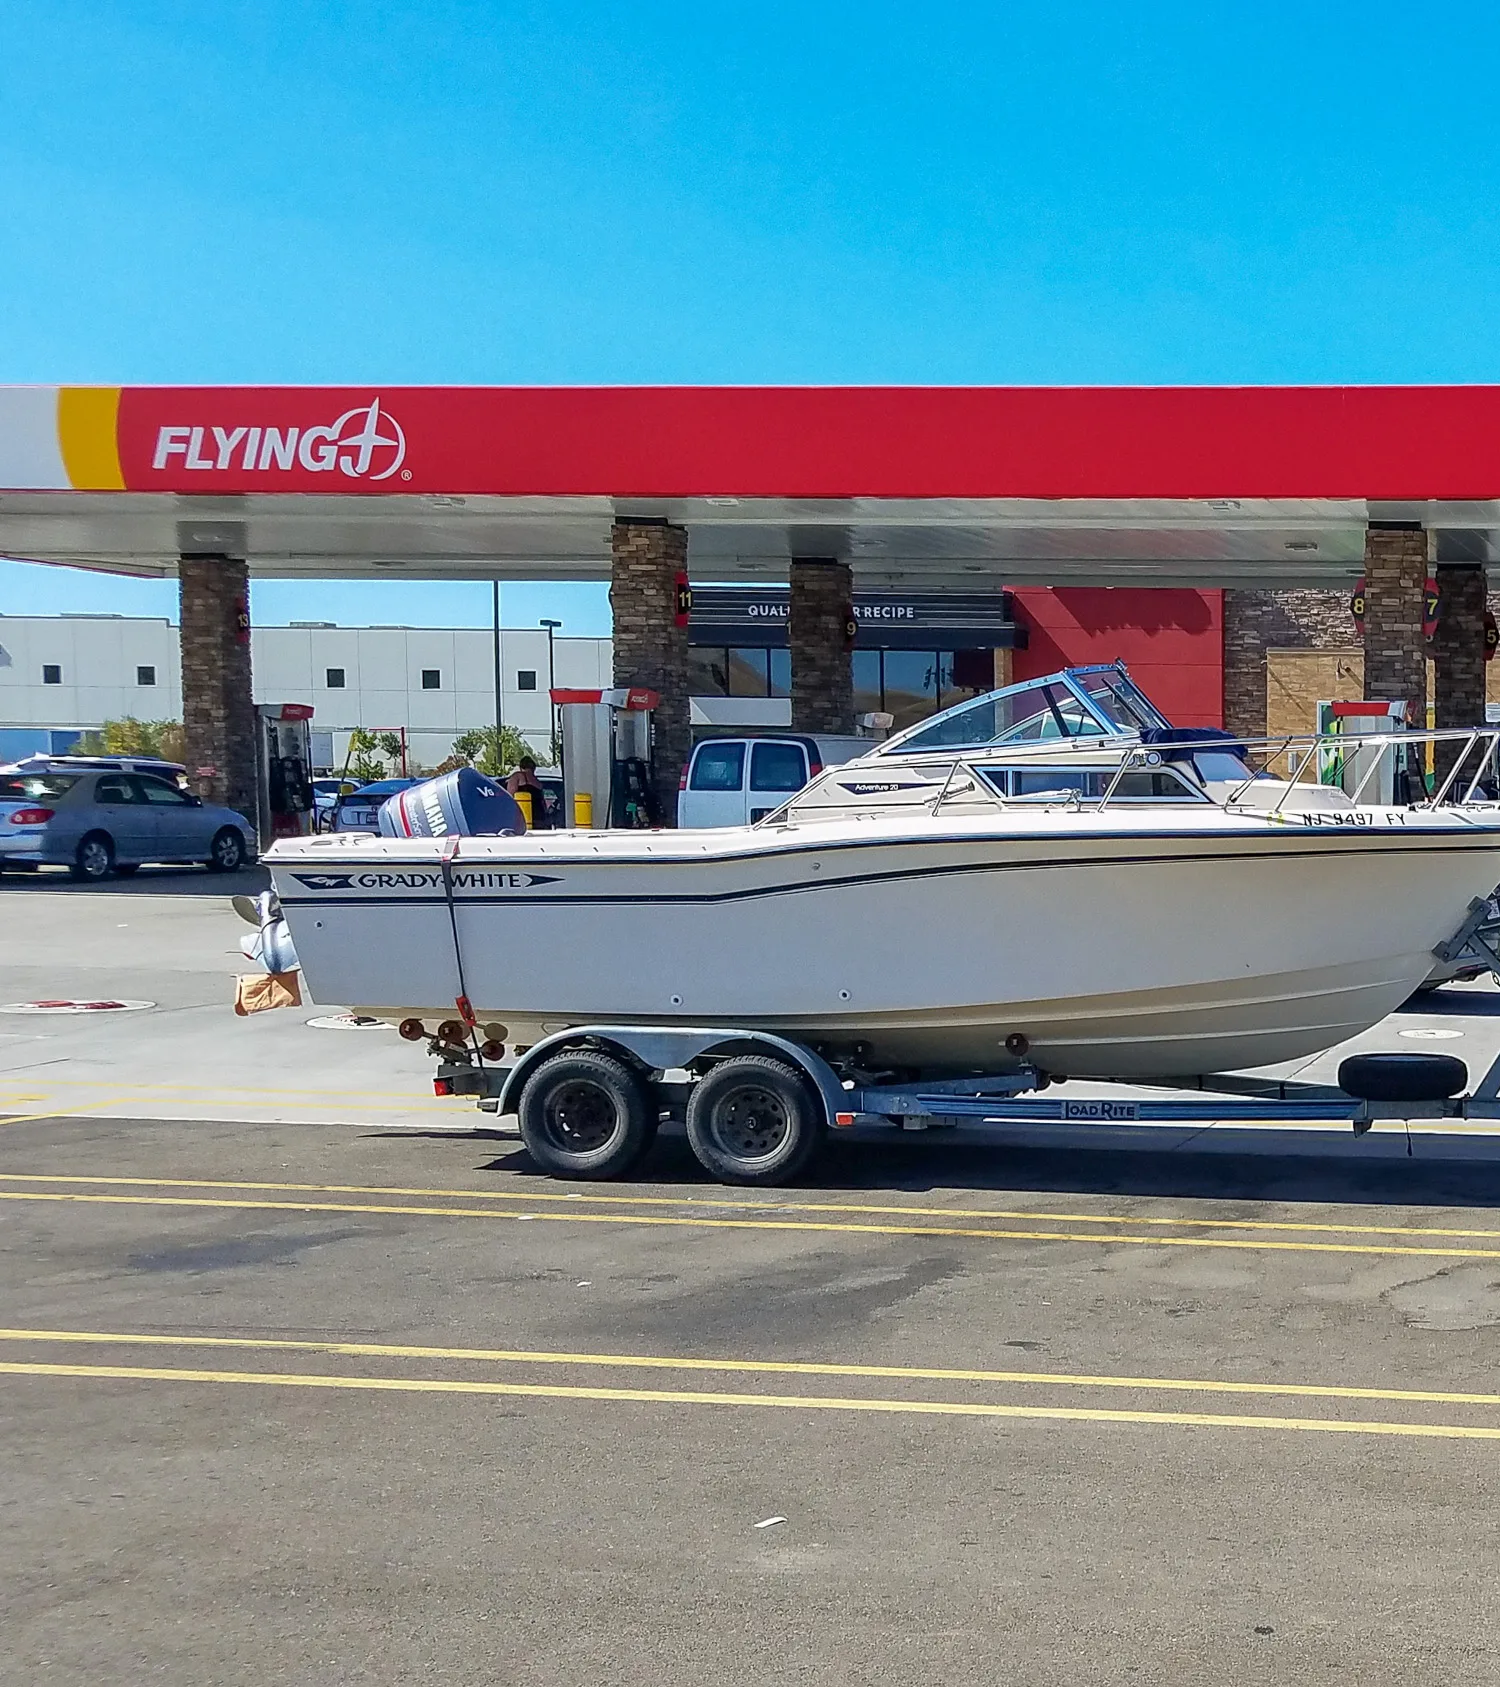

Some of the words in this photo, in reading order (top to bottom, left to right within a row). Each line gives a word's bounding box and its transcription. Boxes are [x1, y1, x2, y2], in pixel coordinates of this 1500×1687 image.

[679, 591, 692, 607] 11
[1353, 598, 1364, 614] 8
[748, 605, 790, 616] QUALI
[864, 606, 914, 618] RECIPE
[1427, 598, 1438, 615] 7
[847, 622, 856, 636] 9
[1487, 629, 1497, 643] 5
[1303, 813, 1321, 826] NJ
[1333, 813, 1374, 825] 9497
[1386, 813, 1405, 825] FY
[357, 873, 520, 888] GRADY-WHITE
